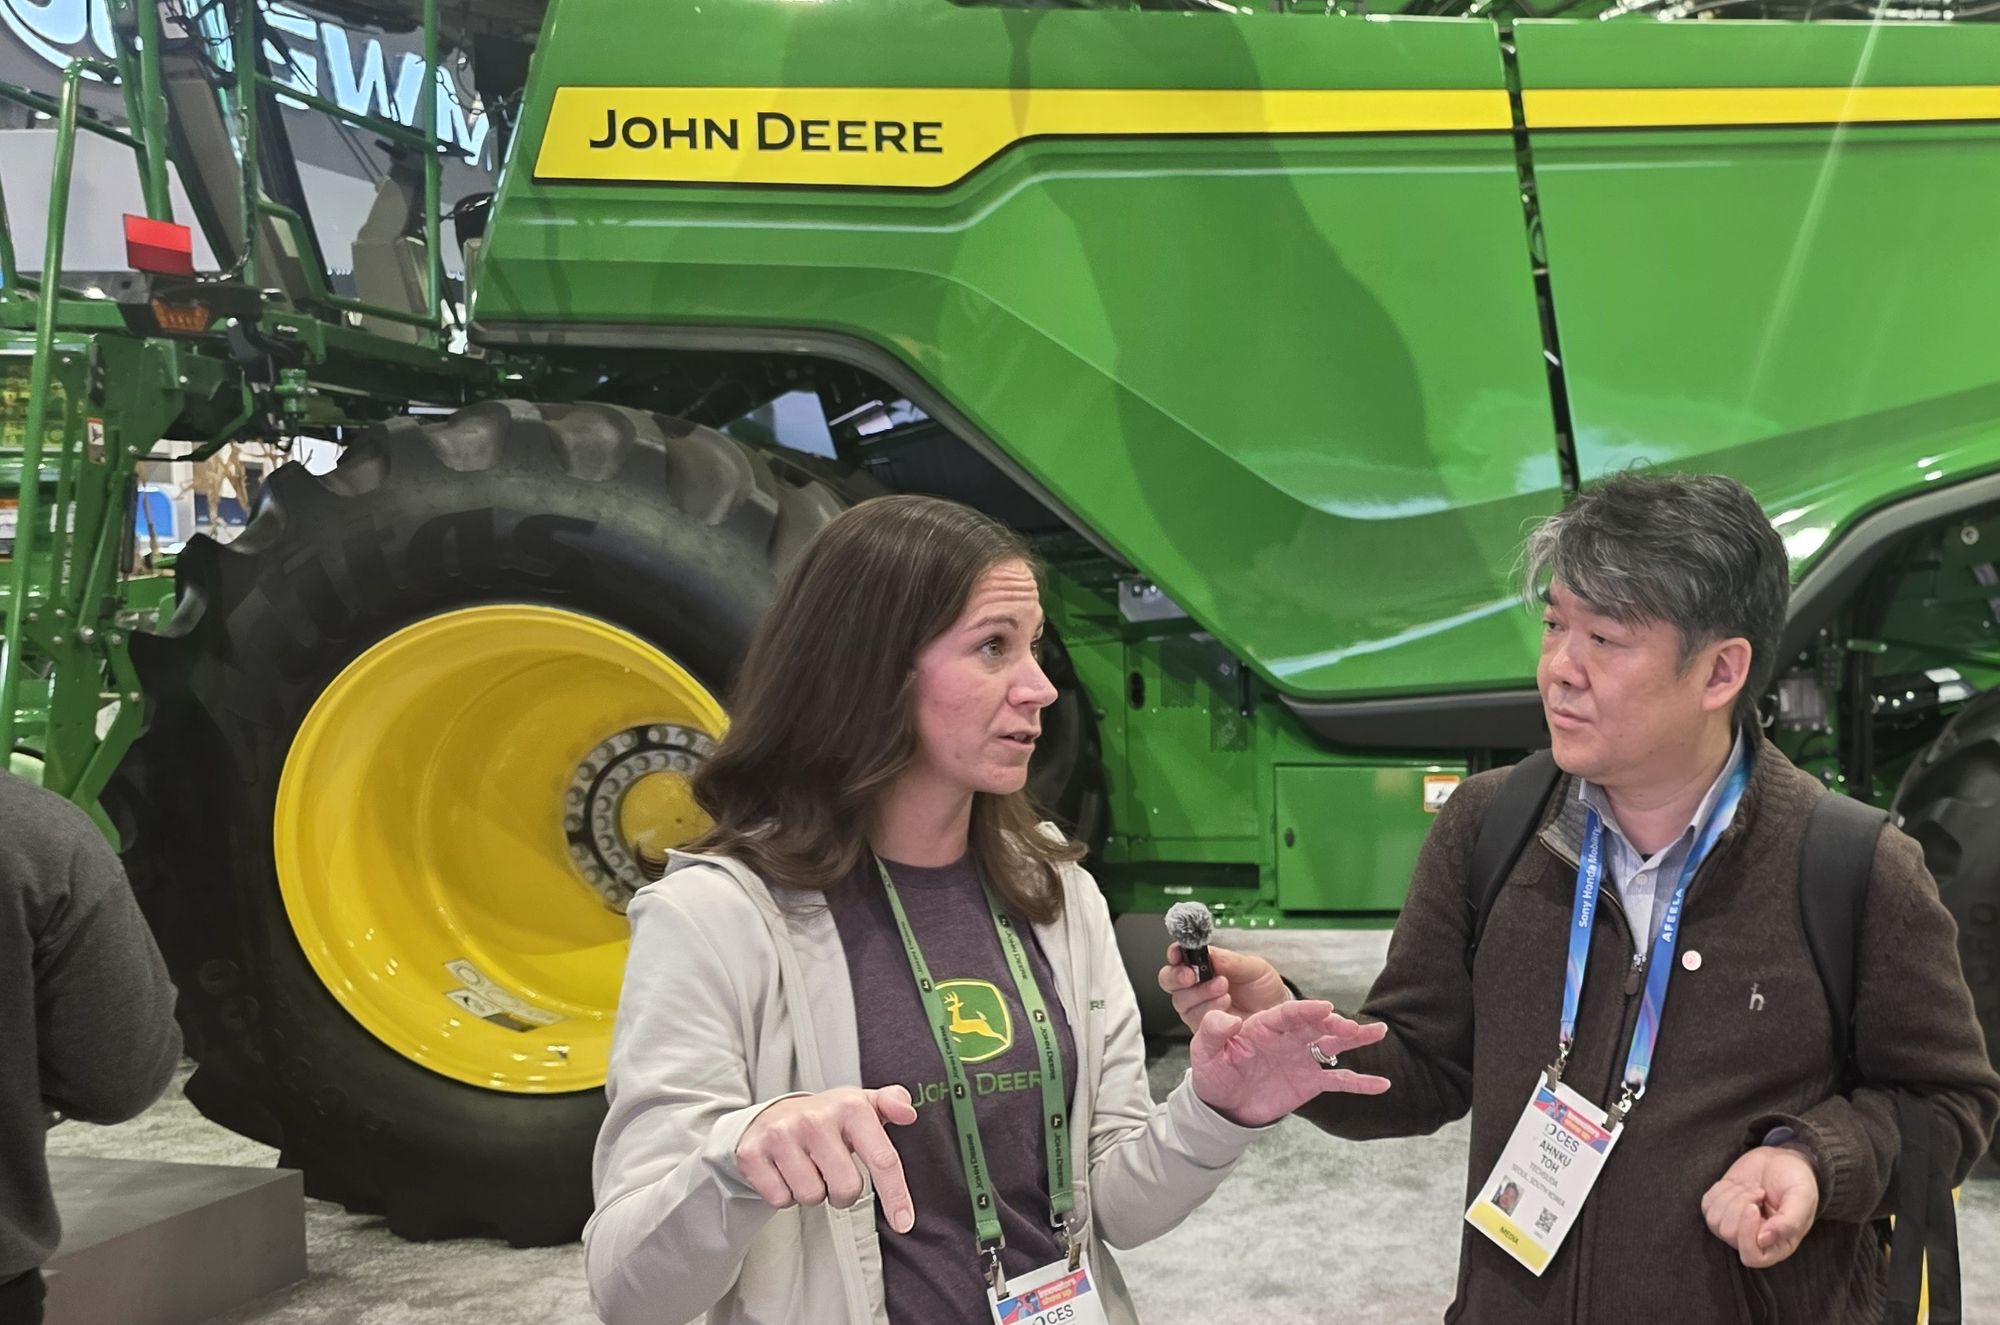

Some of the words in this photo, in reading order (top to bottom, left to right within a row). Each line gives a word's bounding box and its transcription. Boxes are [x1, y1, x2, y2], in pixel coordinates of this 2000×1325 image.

[589, 109, 738, 150] JOHN
[756, 111, 944, 153] DEERE
[1582, 864, 1597, 899] Honda
[1578, 900, 1593, 928] Sony
[1661, 887, 1683, 943] AFEELA
[1040, 1026, 1051, 1051] JOHN
[1045, 1051, 1056, 1080] DEERE
[975, 1070, 1042, 1096] DEER
[1053, 1132, 1063, 1158] JOHN
[1538, 1138, 1572, 1167] AHNKU
[1556, 1127, 1580, 1153] CES
[1540, 1154, 1560, 1173] TOH
[1499, 1225, 1519, 1246] MEDIA
[1046, 1304, 1074, 1325] CES
